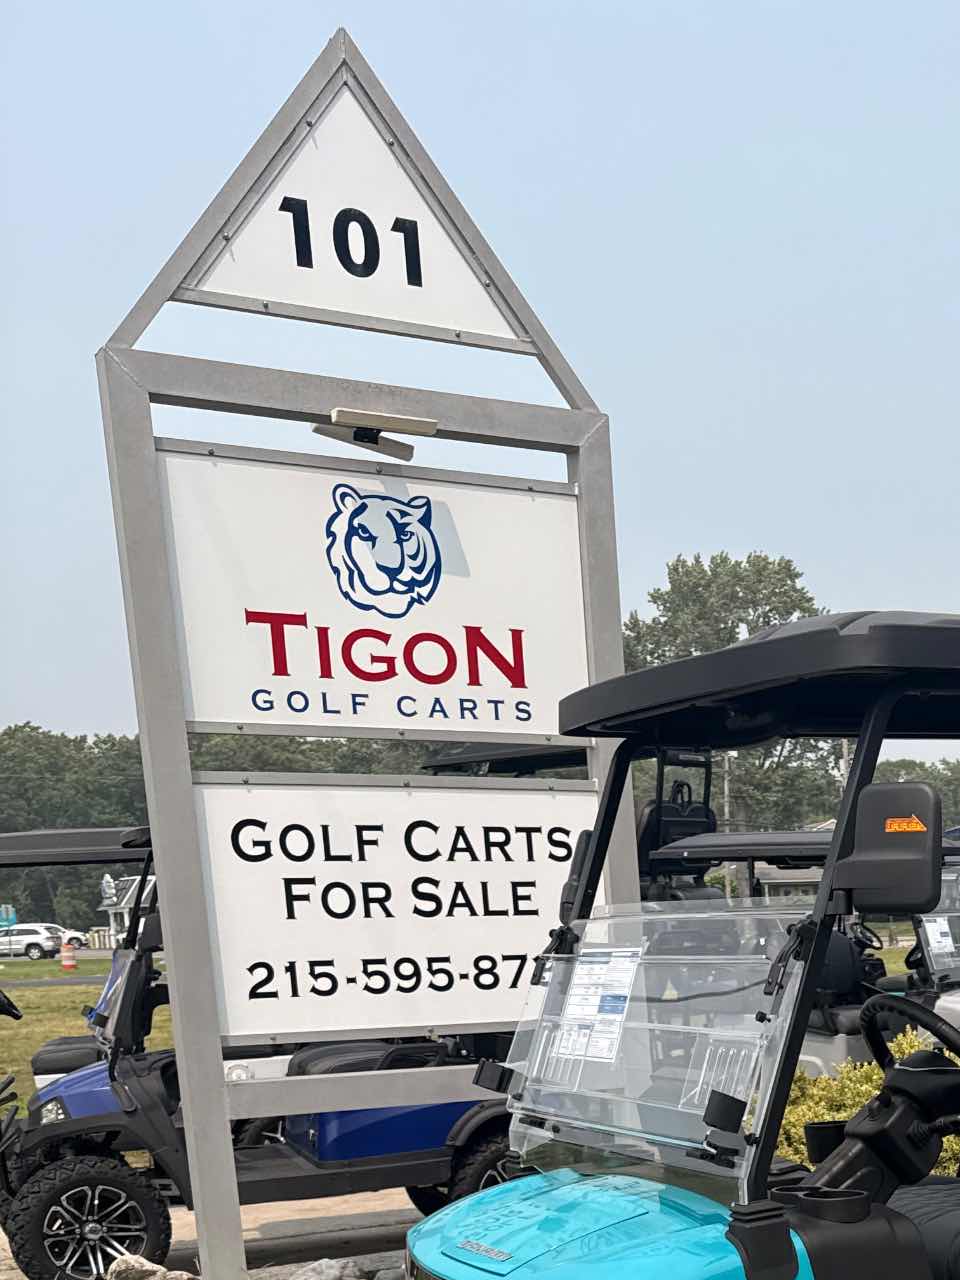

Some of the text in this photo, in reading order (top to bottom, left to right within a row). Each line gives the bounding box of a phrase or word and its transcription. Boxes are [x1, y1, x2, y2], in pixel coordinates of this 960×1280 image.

[279, 196, 423, 287] 101
[244, 608, 528, 689] TIGON
[250, 688, 534, 723] GOLF CARTS
[230, 818, 574, 863] GOLF CARTS
[282, 876, 540, 920] FOR SALE
[246, 954, 539, 998] 215-595-87
